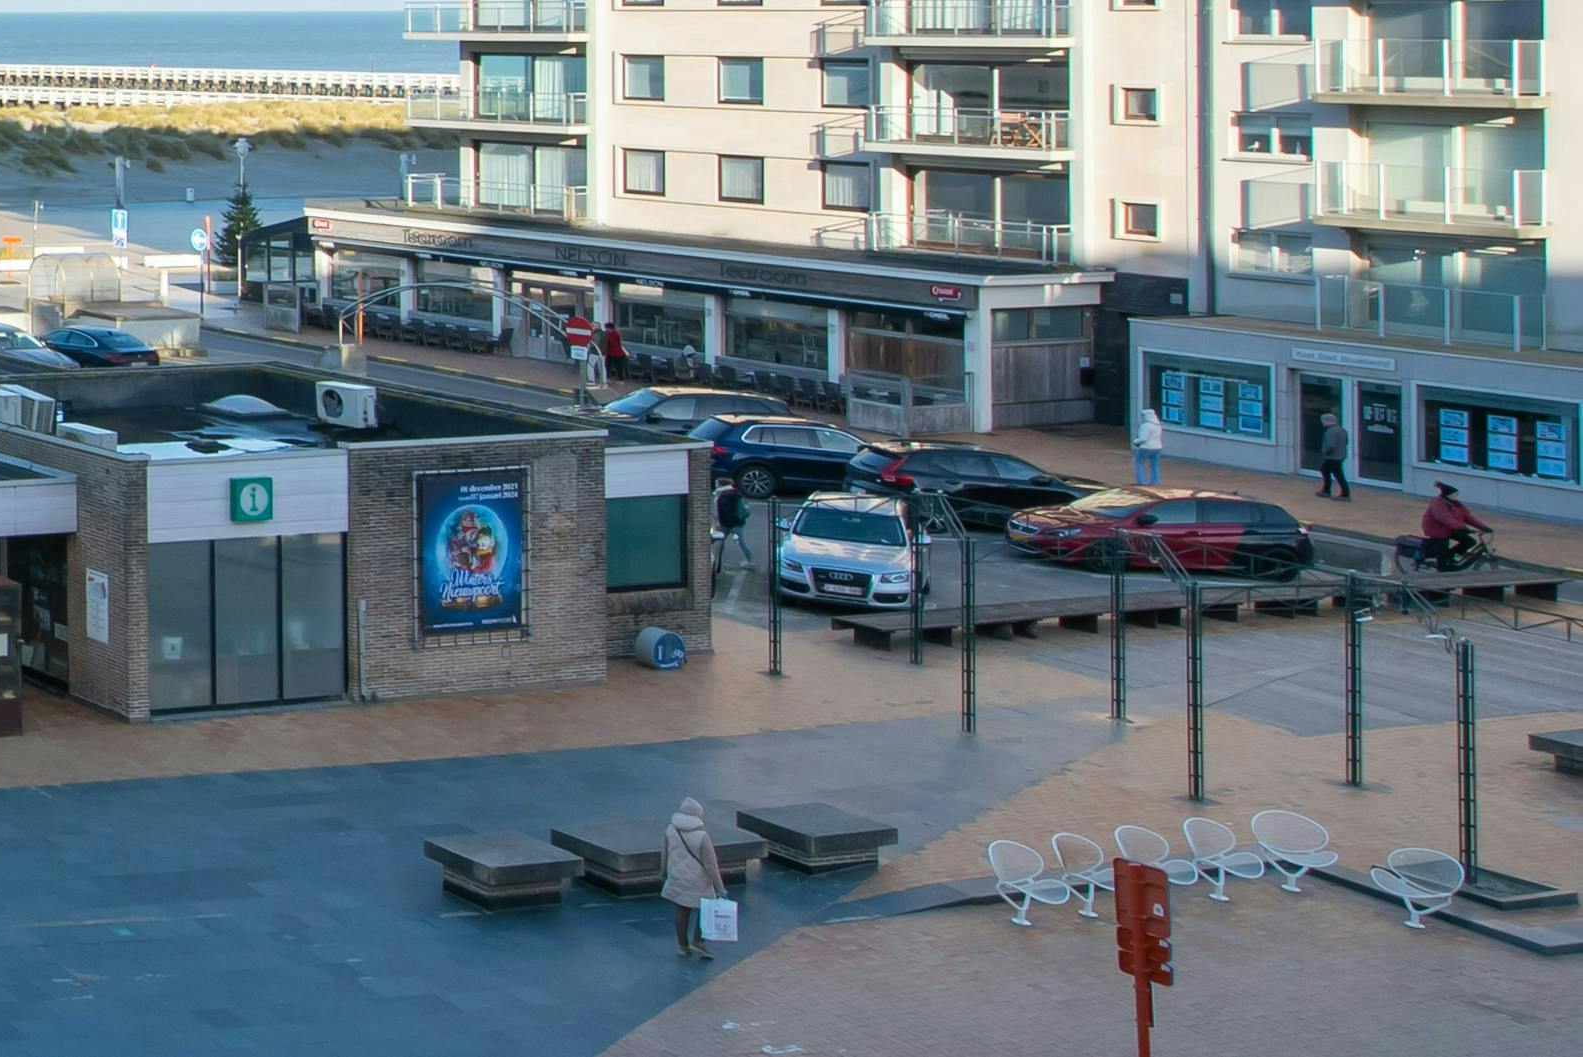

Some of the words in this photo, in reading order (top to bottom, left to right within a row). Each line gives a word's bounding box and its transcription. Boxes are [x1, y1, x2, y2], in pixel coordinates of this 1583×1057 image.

[479, 260, 505, 269] NELSON
[555, 247, 628, 267] NELSON
[636, 278, 664, 287] NELSON
[719, 262, 807, 285] Tearoom
[469, 484, 501, 492] december
[451, 569, 495, 587] Winters
[440, 581, 505, 602] Nieuwpoort
